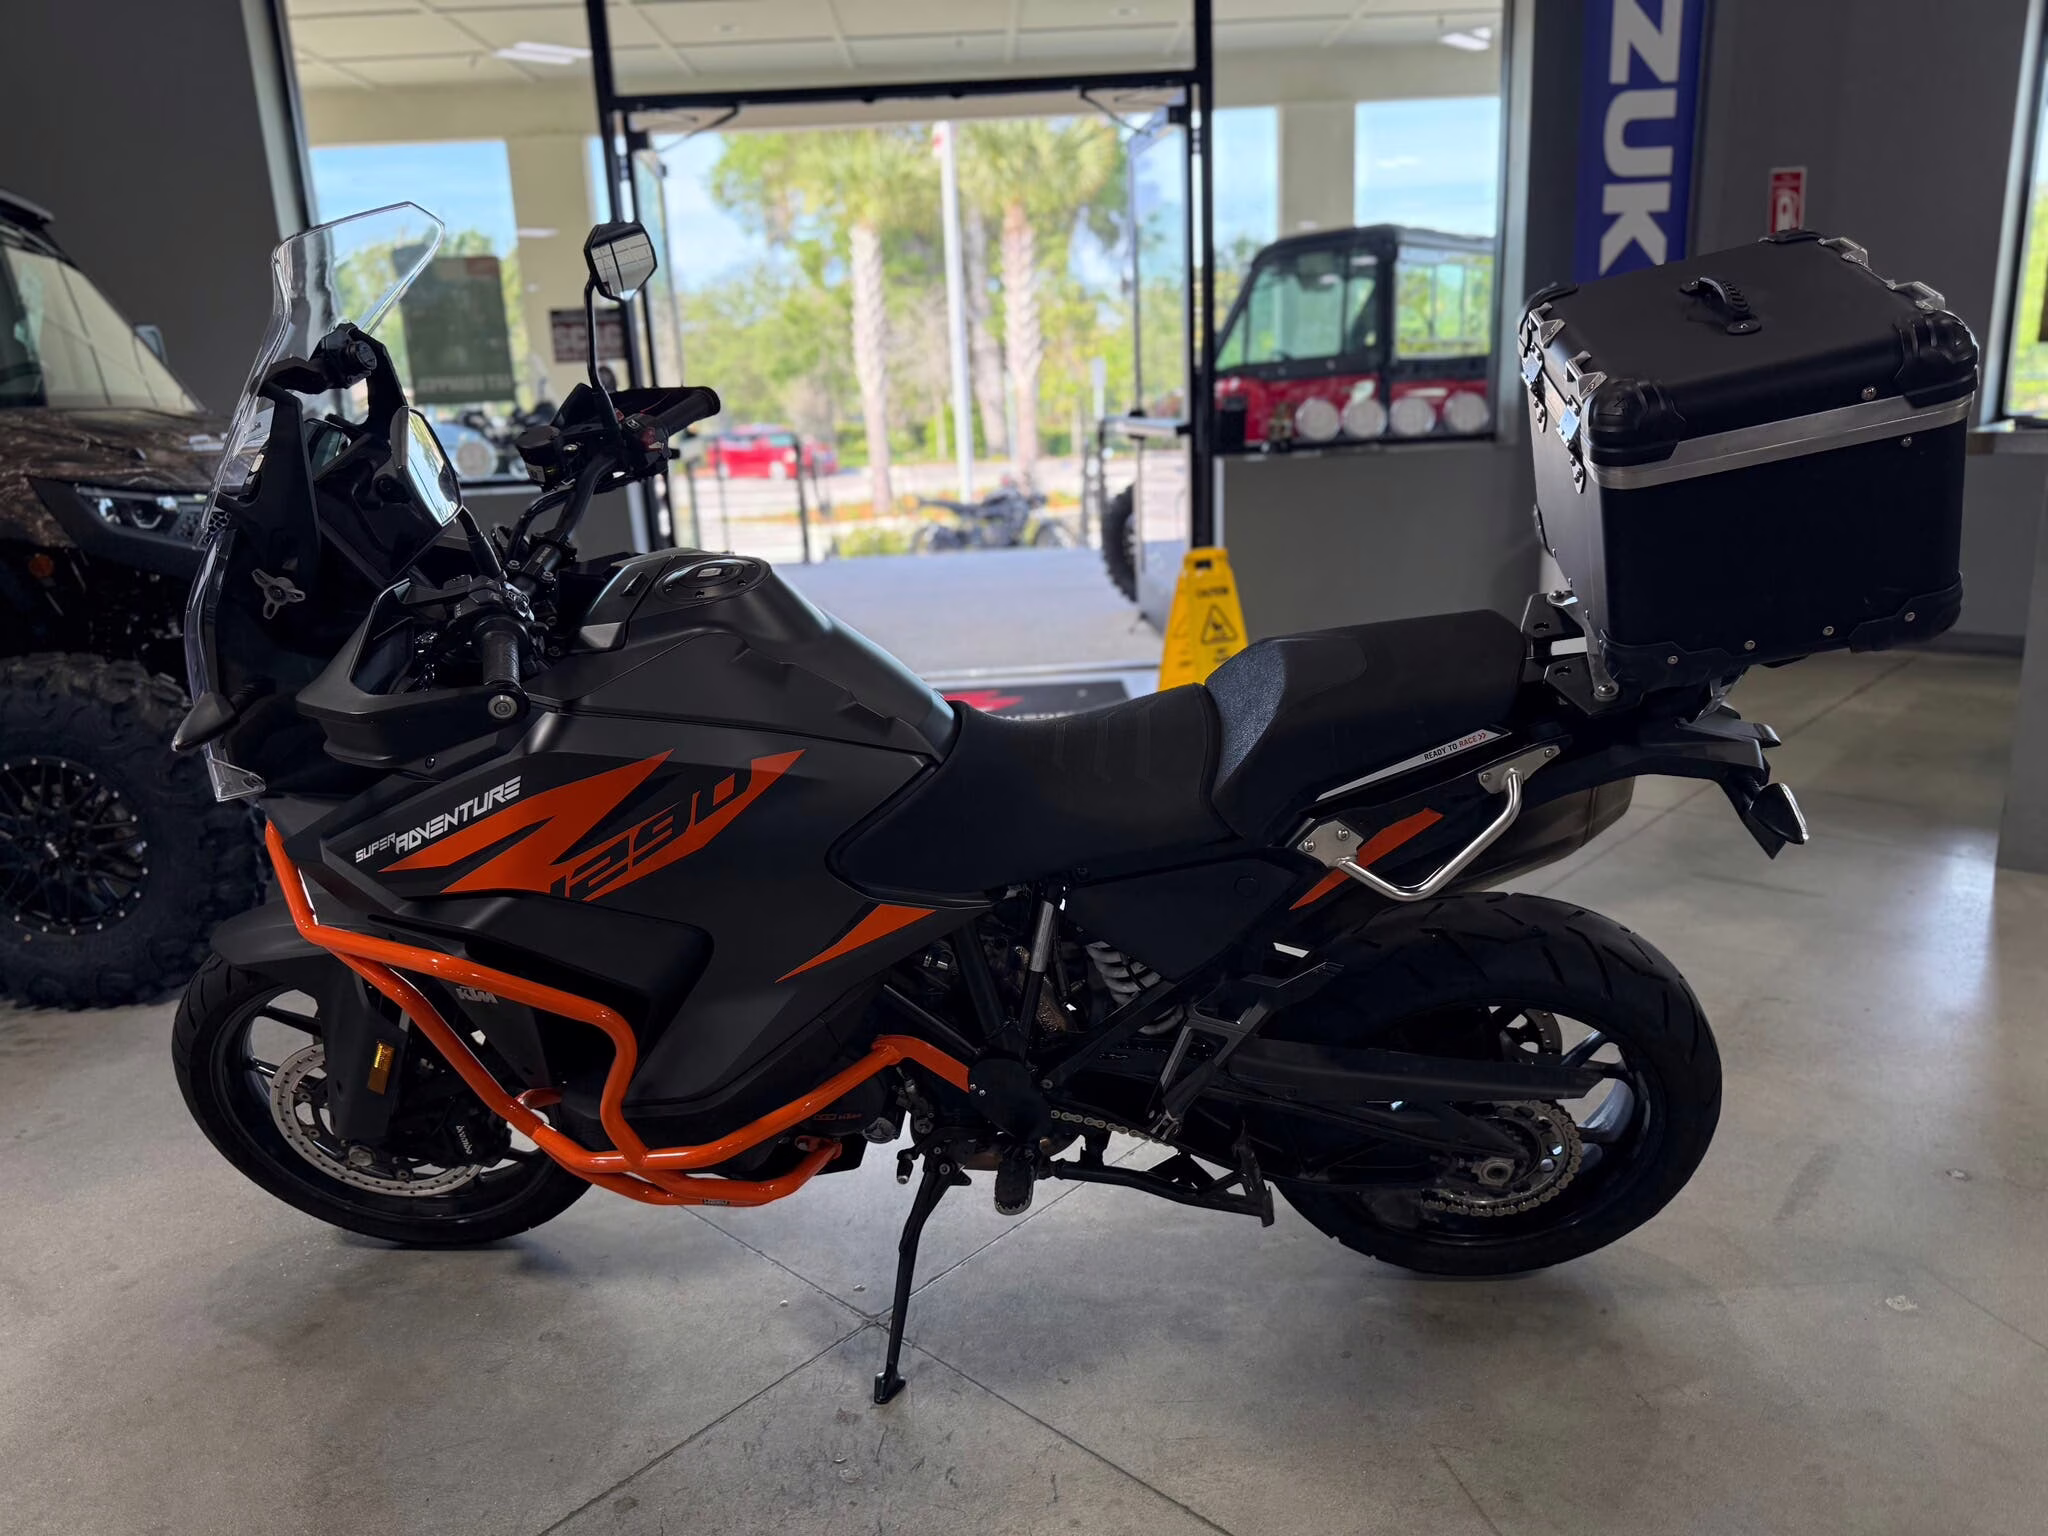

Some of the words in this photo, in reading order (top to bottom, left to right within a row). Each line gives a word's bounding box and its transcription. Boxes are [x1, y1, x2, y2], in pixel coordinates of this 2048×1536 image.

[1423, 747, 1447, 761] READY
[1448, 743, 1458, 752] TO
[1459, 735, 1478, 748] RACE
[355, 832, 396, 863] SUPER
[395, 775, 521, 855] ADVENTURE
